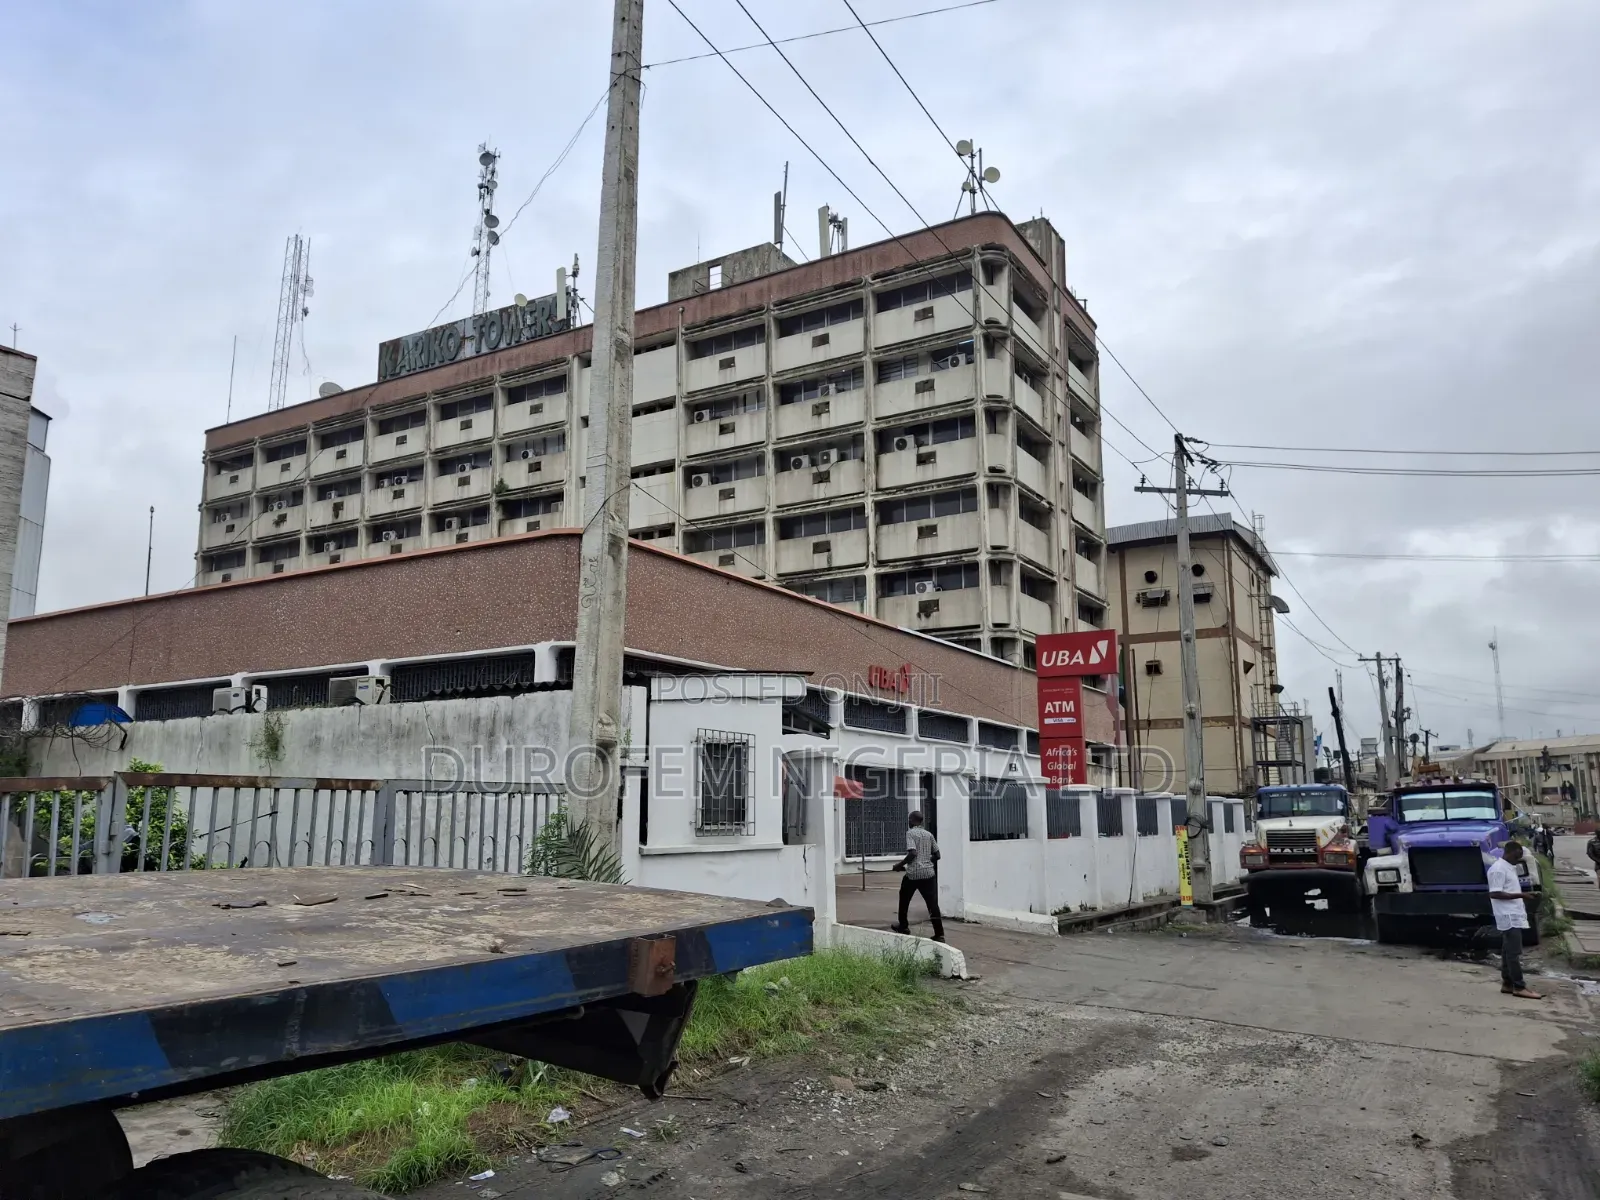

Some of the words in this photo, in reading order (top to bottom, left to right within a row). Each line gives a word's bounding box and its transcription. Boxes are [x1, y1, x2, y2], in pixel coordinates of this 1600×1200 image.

[380, 324, 462, 380] KARIKO
[1041, 649, 1085, 667] UBA
[868, 664, 901, 691] UBA
[1044, 700, 1075, 714] ATM
[1045, 747, 1078, 757] Africa's
[1047, 760, 1077, 771] Global
[1051, 774, 1075, 784] Bank
